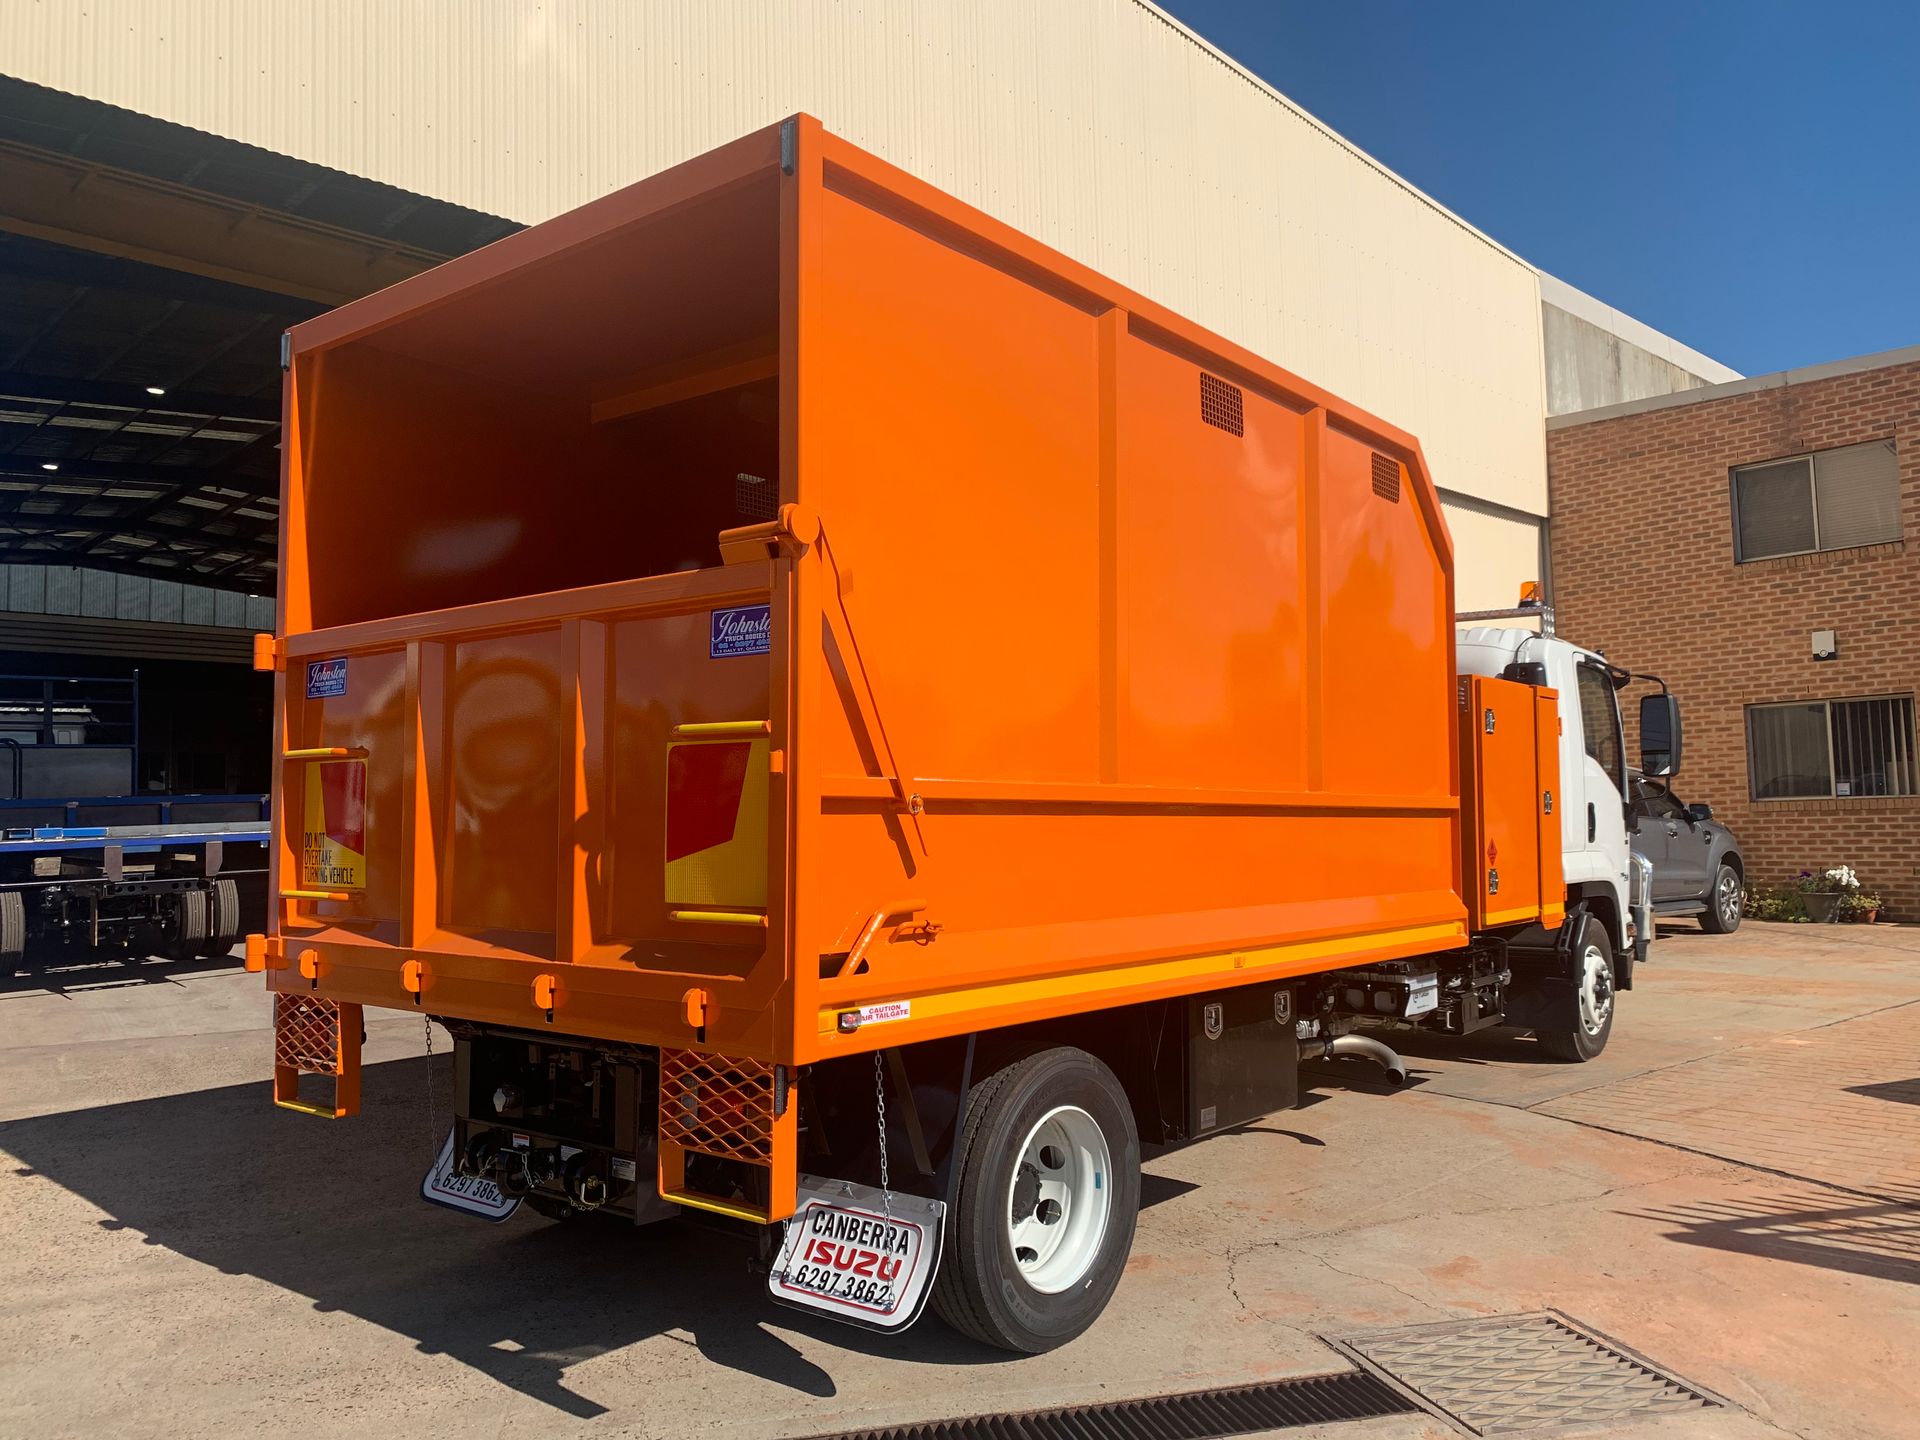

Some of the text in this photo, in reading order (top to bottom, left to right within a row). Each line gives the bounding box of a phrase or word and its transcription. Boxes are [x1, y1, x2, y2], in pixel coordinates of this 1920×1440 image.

[724, 634, 744, 642] TRUCK
[744, 632, 766, 640] BODIES
[308, 664, 346, 688] Johnston
[304, 832, 326, 849] DO NOT
[304, 849, 333, 867] OVERTAKE
[304, 866, 354, 885] TURNING VEHICLE
[868, 1004, 901, 1015] CAUTION
[875, 1009, 909, 1018] TAILGATE
[442, 1172, 475, 1195] 6297
[811, 1210, 911, 1256] CANBERRA
[803, 1238, 902, 1281] ISUZU
[795, 1264, 890, 1306] 6297 3862
